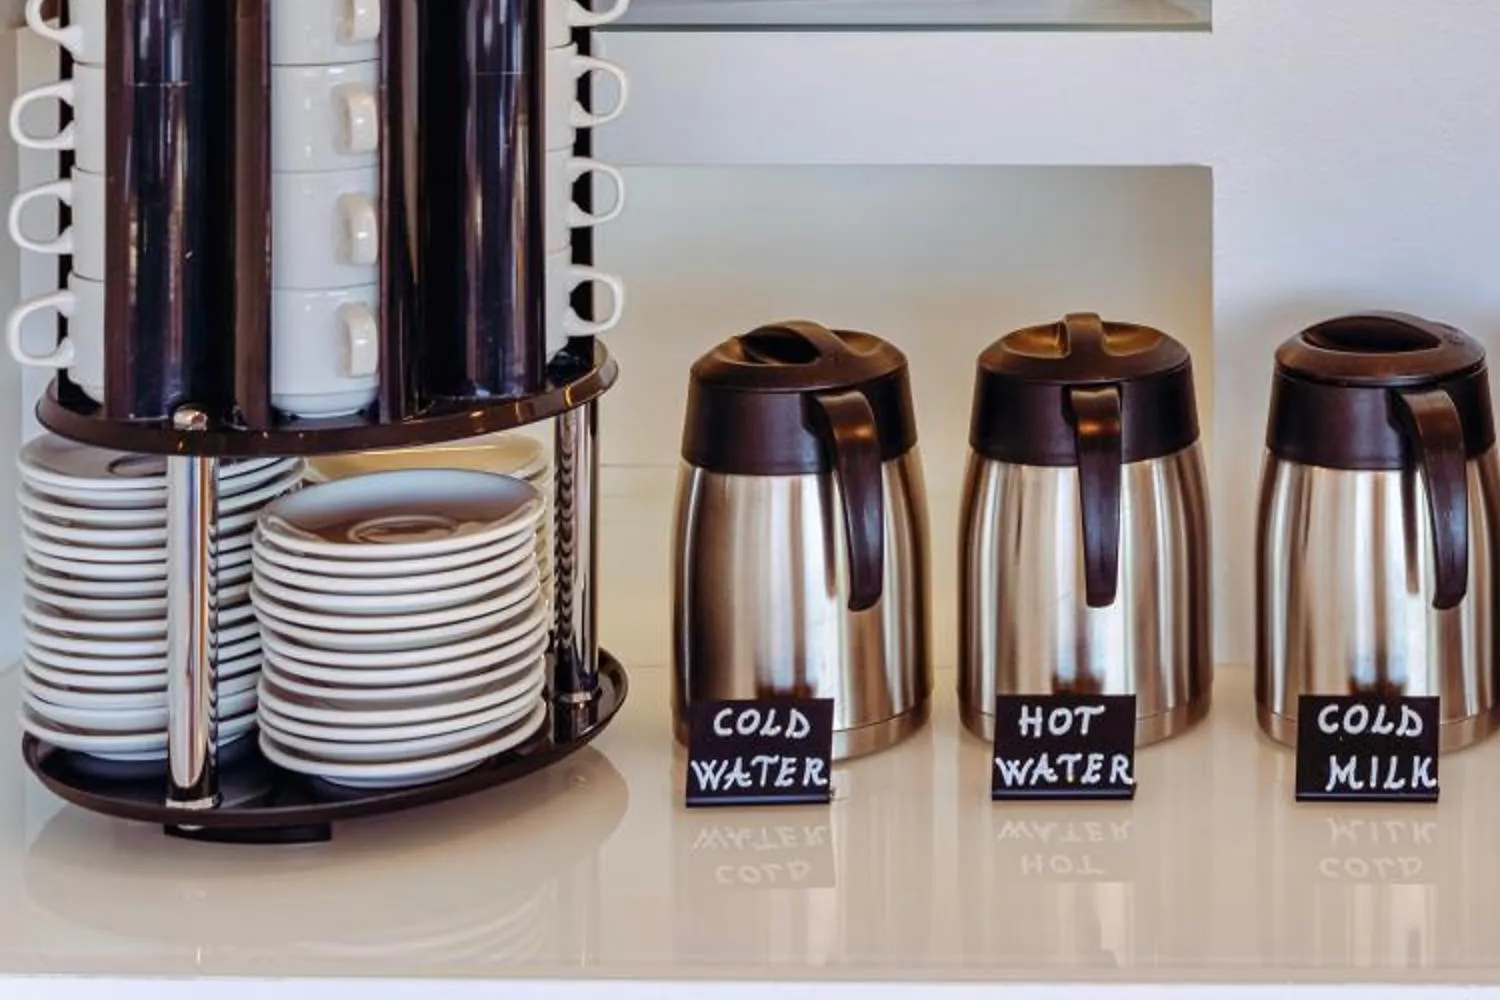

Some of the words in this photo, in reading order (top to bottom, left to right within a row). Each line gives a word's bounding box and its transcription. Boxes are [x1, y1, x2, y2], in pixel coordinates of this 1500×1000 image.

[713, 707, 811, 739] COLD
[1019, 704, 1106, 737] HOT
[1317, 704, 1424, 737] COLD
[690, 754, 829, 791] WATER
[995, 752, 1134, 787] WATER
[1325, 754, 1437, 792] MILK
